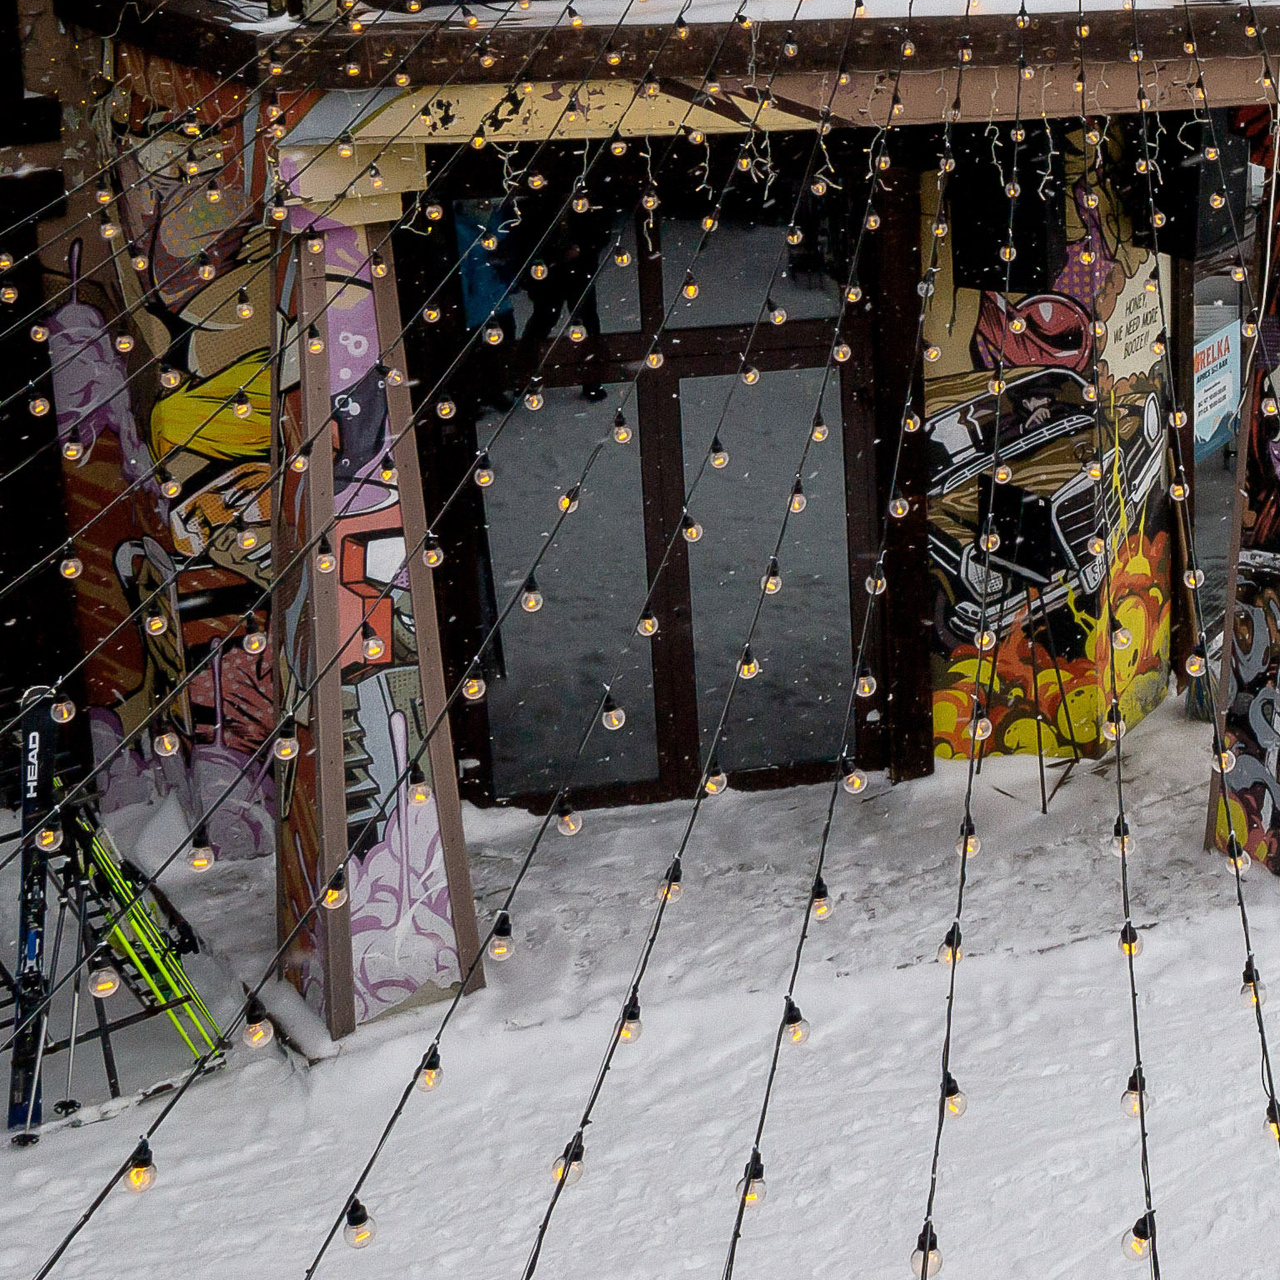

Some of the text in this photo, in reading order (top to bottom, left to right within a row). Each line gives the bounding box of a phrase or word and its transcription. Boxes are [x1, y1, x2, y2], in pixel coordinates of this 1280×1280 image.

[1125, 315, 1141, 338] NEED
[1194, 334, 1231, 374] GRELKA
[26, 731, 40, 798] HEAD
